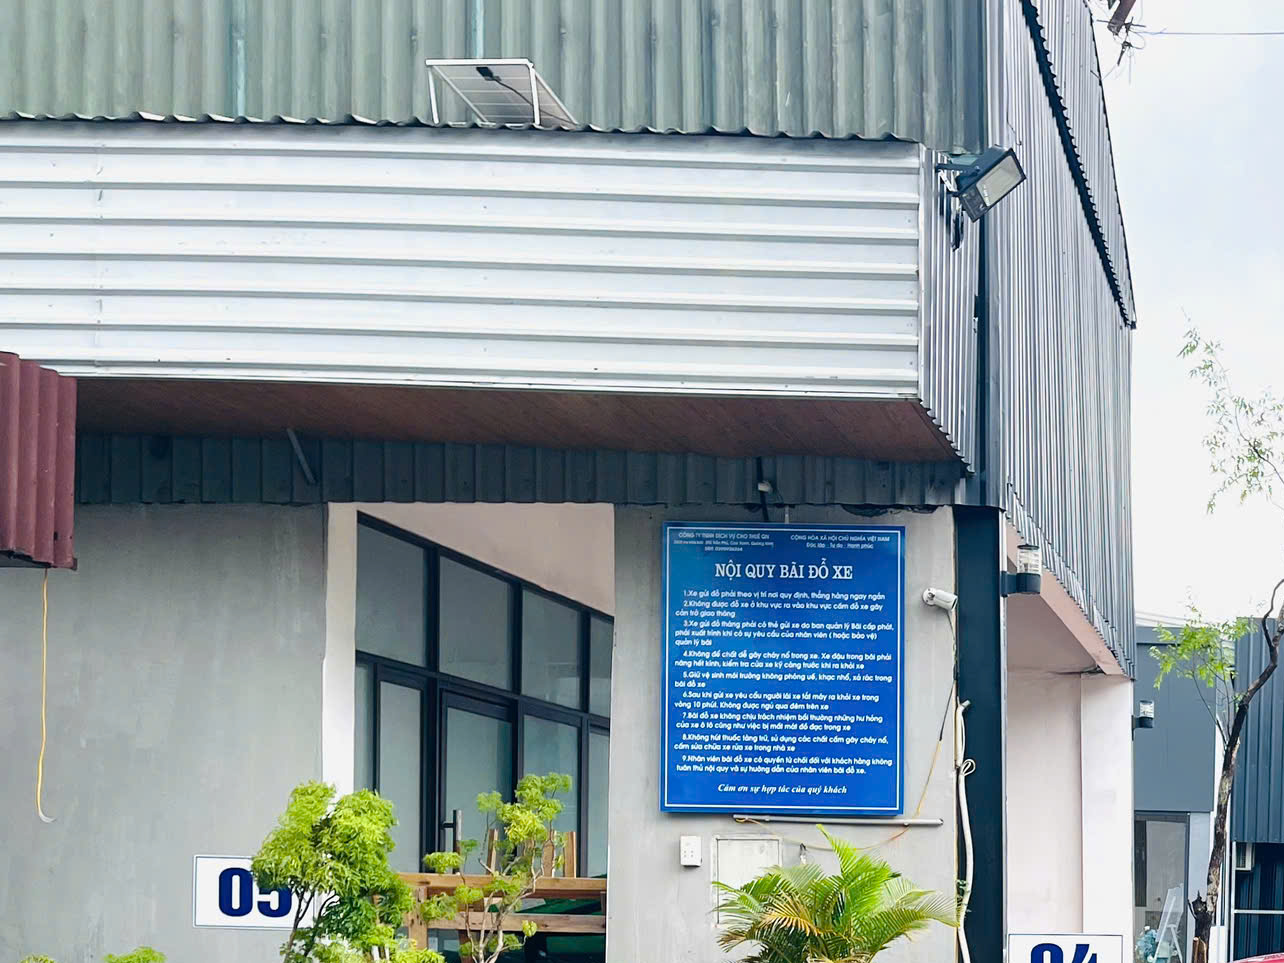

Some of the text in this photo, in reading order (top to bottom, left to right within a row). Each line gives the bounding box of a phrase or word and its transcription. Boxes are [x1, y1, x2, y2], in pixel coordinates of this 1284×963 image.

[716, 558, 852, 580] NỘI QUY BÃI ĐỖ XE
[219, 867, 292, 917] 05
